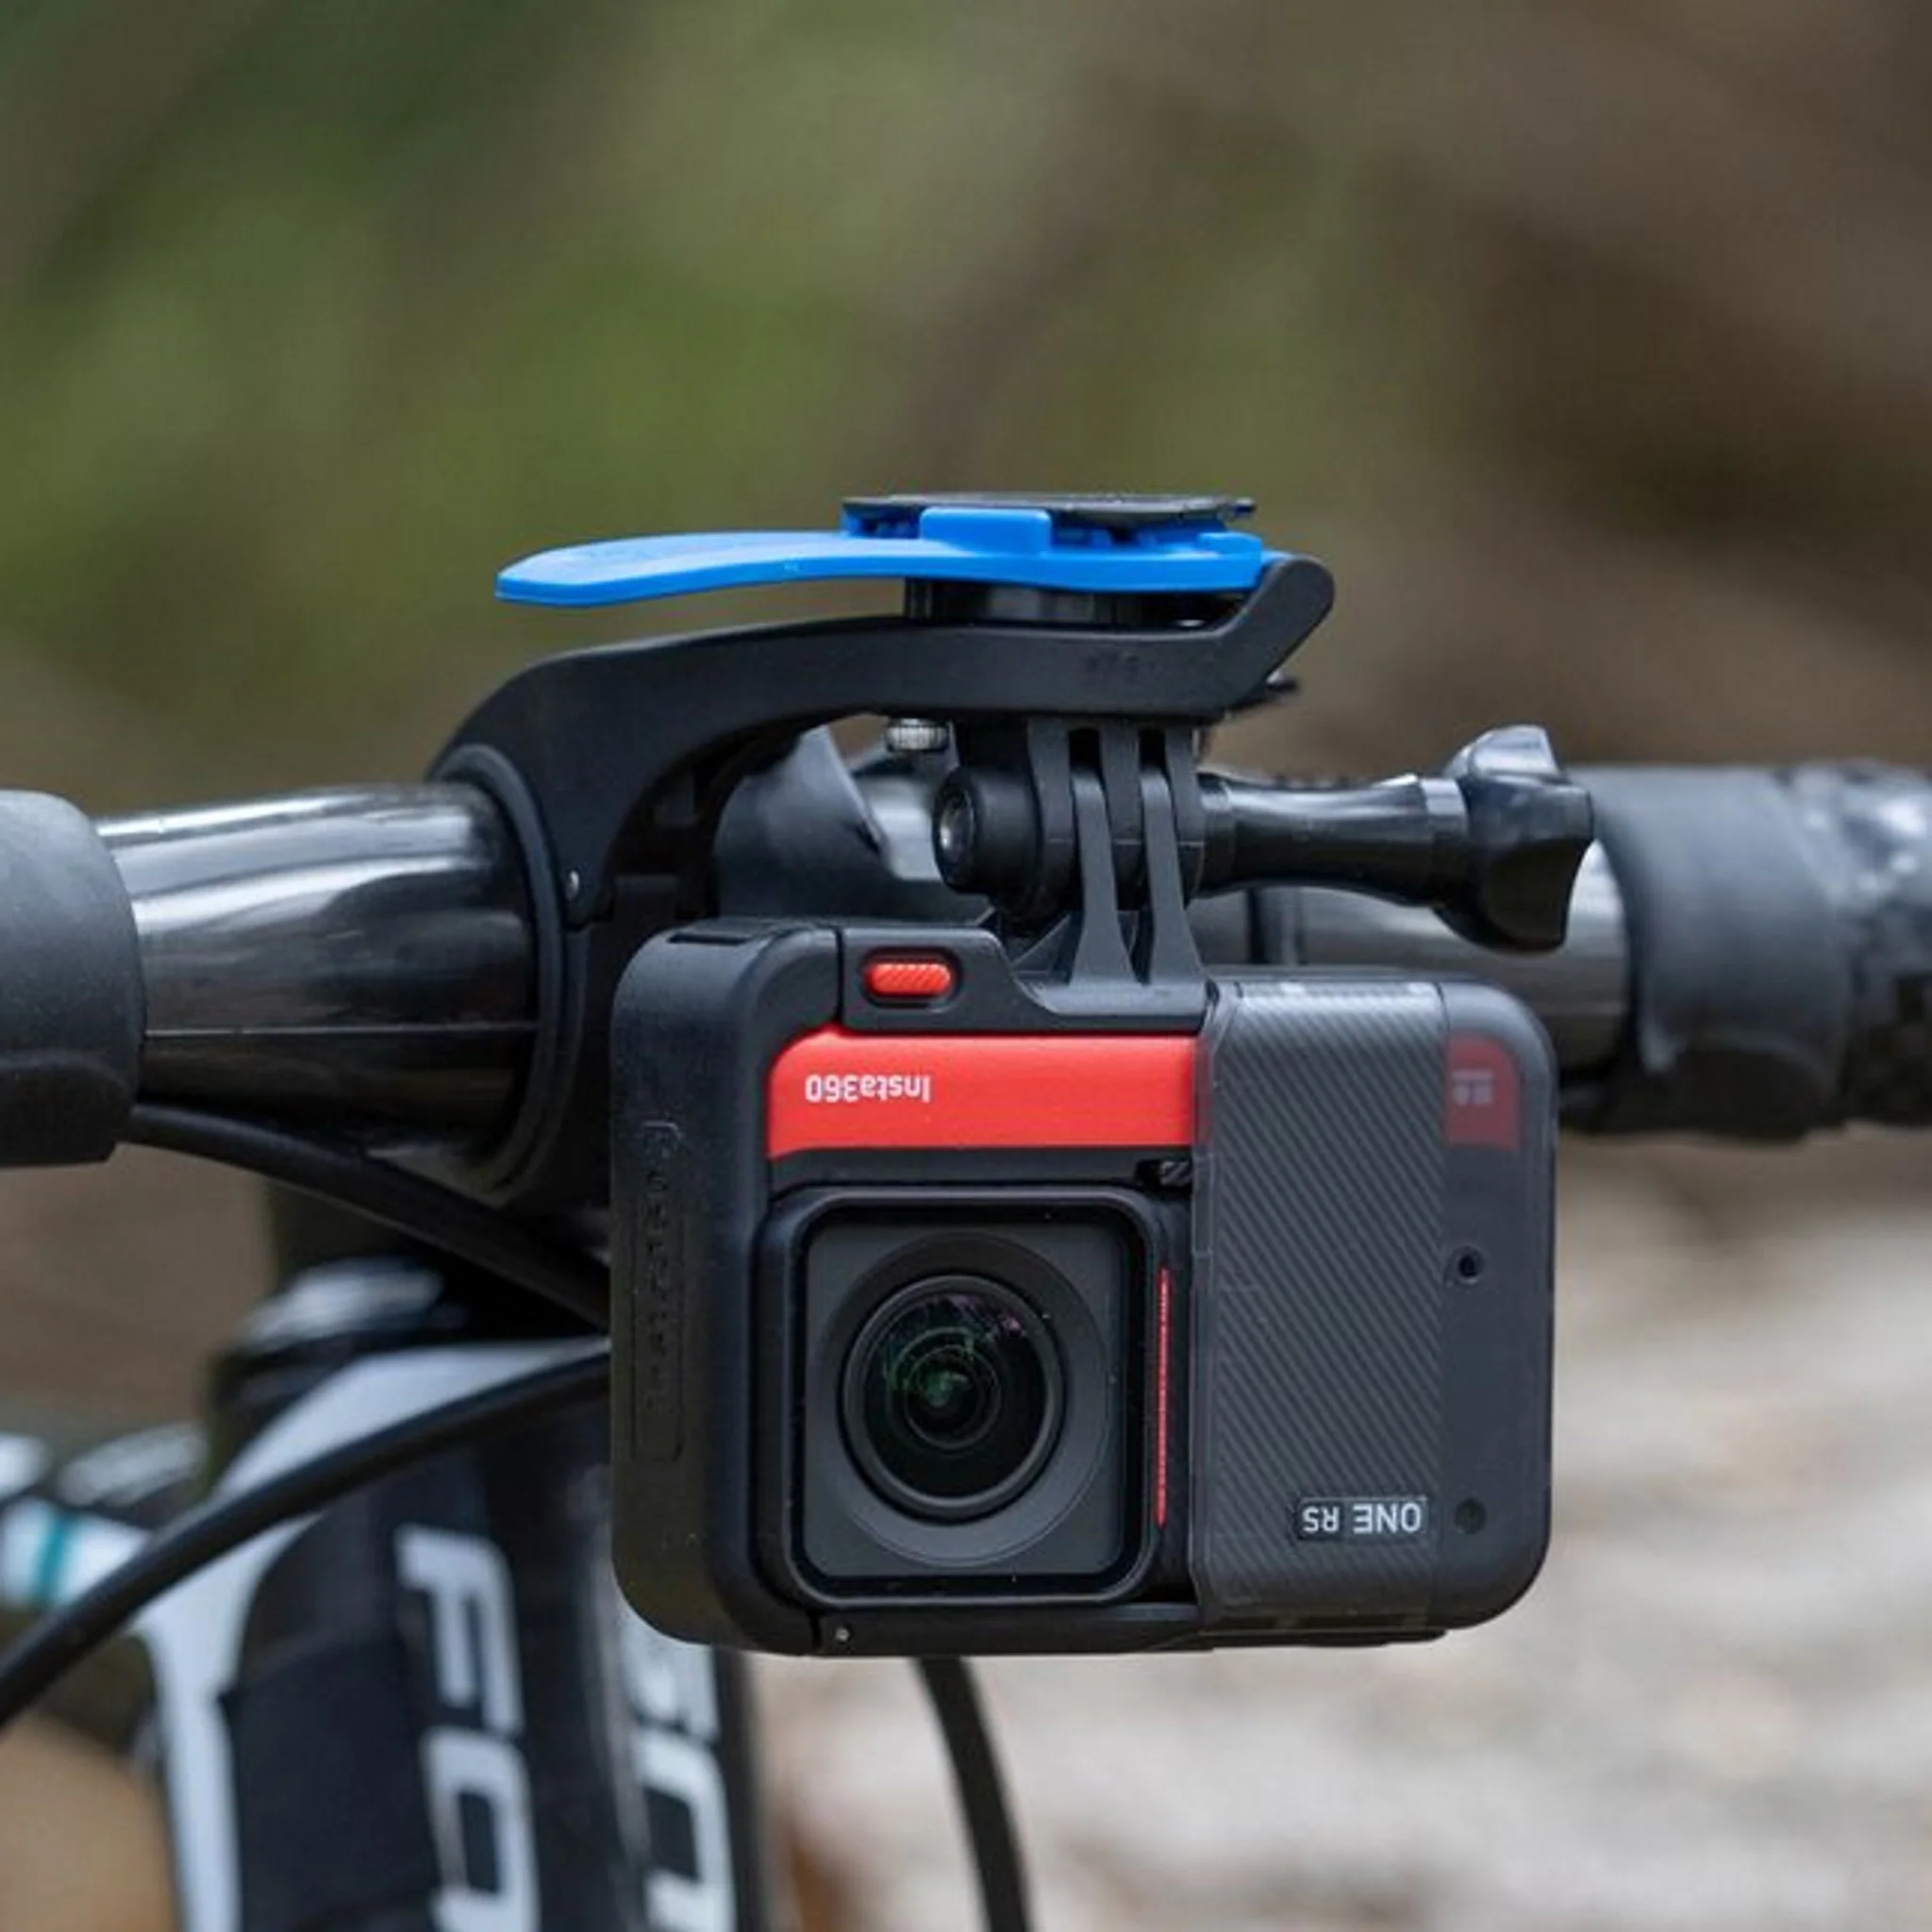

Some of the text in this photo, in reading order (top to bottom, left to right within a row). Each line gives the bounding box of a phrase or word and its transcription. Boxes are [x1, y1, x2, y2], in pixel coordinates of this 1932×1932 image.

[805, 1074, 930, 1103] Insta360
[1302, 1502, 1422, 1534] ONE RS
